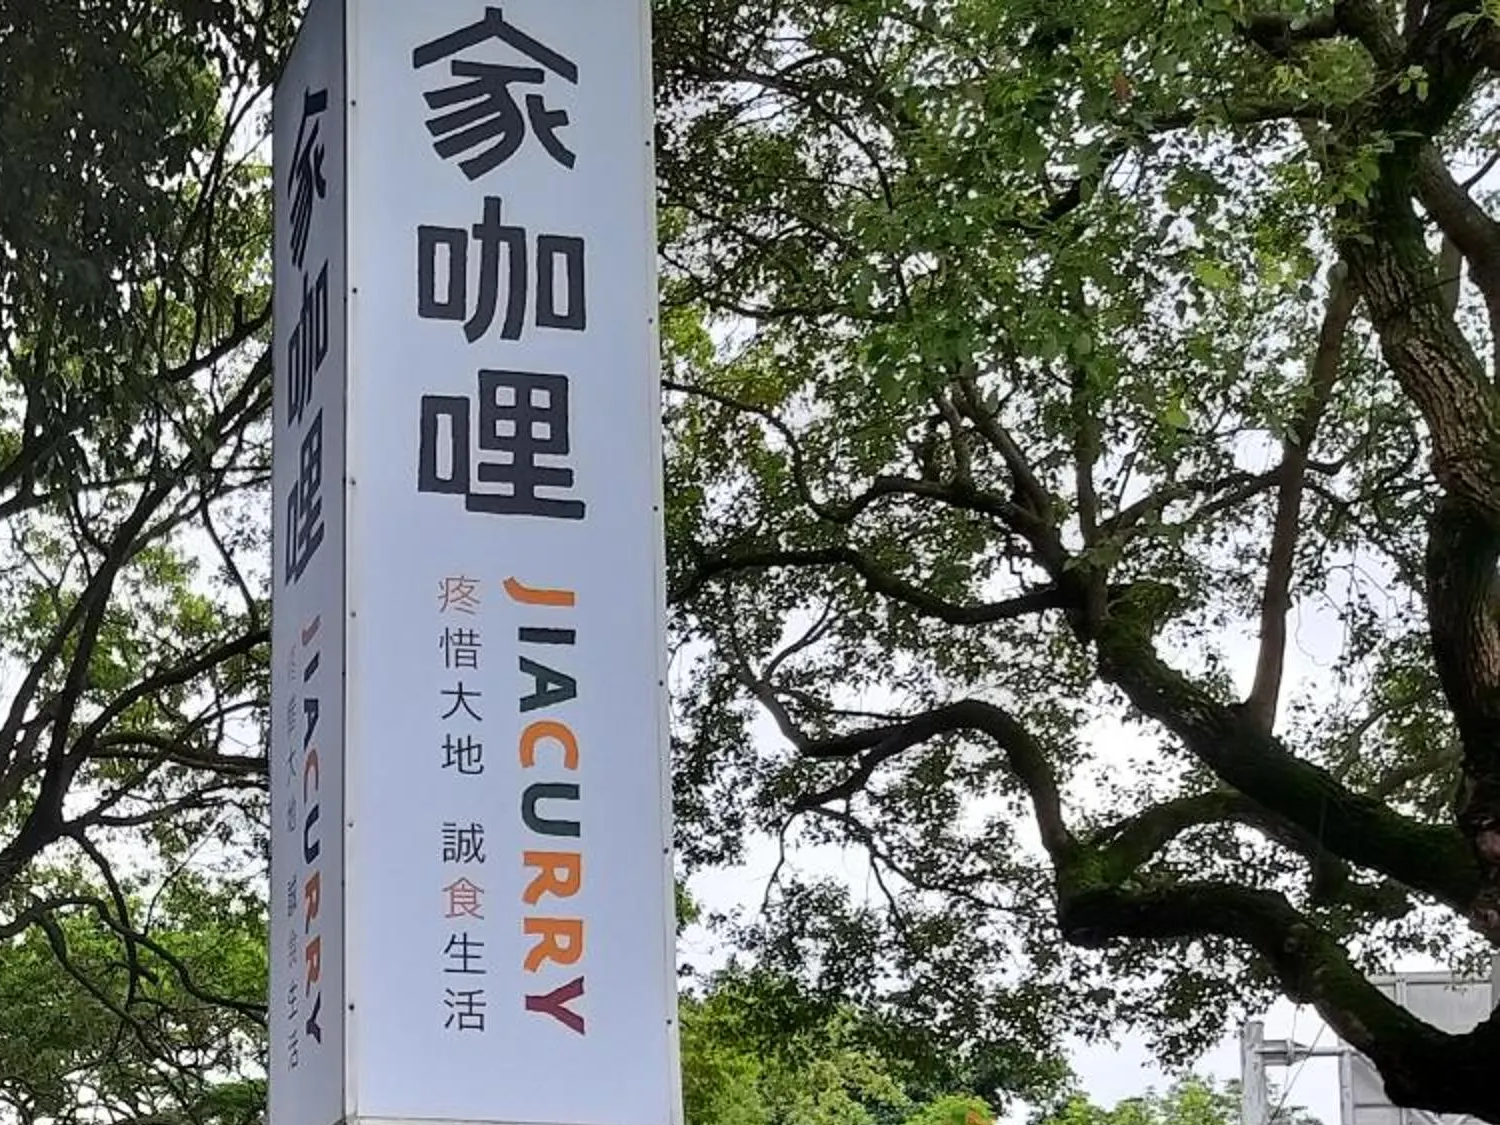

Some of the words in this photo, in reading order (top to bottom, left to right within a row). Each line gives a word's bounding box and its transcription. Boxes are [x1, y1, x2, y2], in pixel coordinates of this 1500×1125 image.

[285, 86, 329, 586] 家咖哩
[412, 5, 587, 520] 家咖哩
[302, 613, 322, 1045] JIACURRY
[437, 574, 485, 776] 疼惜大地
[502, 575, 586, 1037] JIACURRY
[440, 822, 487, 1034] 誠食生活
